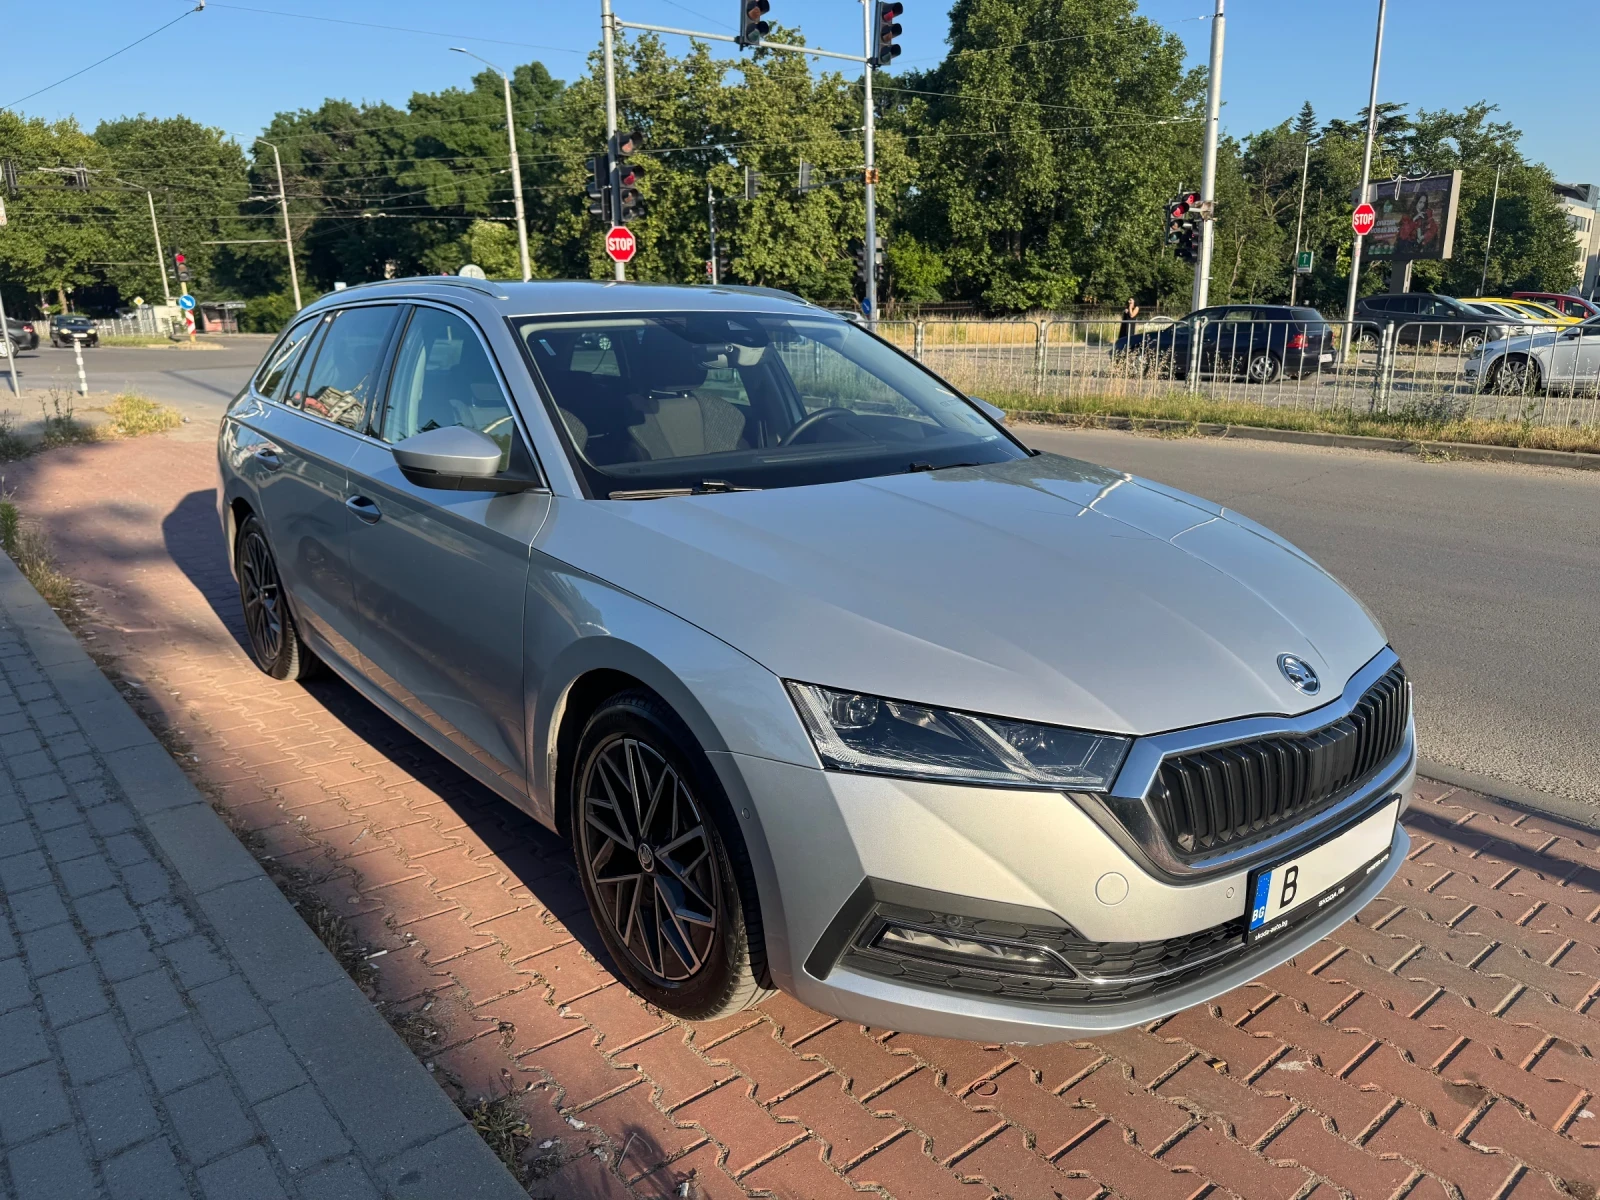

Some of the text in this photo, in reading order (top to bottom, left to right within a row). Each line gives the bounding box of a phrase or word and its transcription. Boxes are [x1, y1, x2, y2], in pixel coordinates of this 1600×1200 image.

[1354, 213, 1373, 225] STOP
[609, 237, 633, 251] STOP
[1279, 865, 1299, 909] B
[1252, 906, 1265, 922] BG
